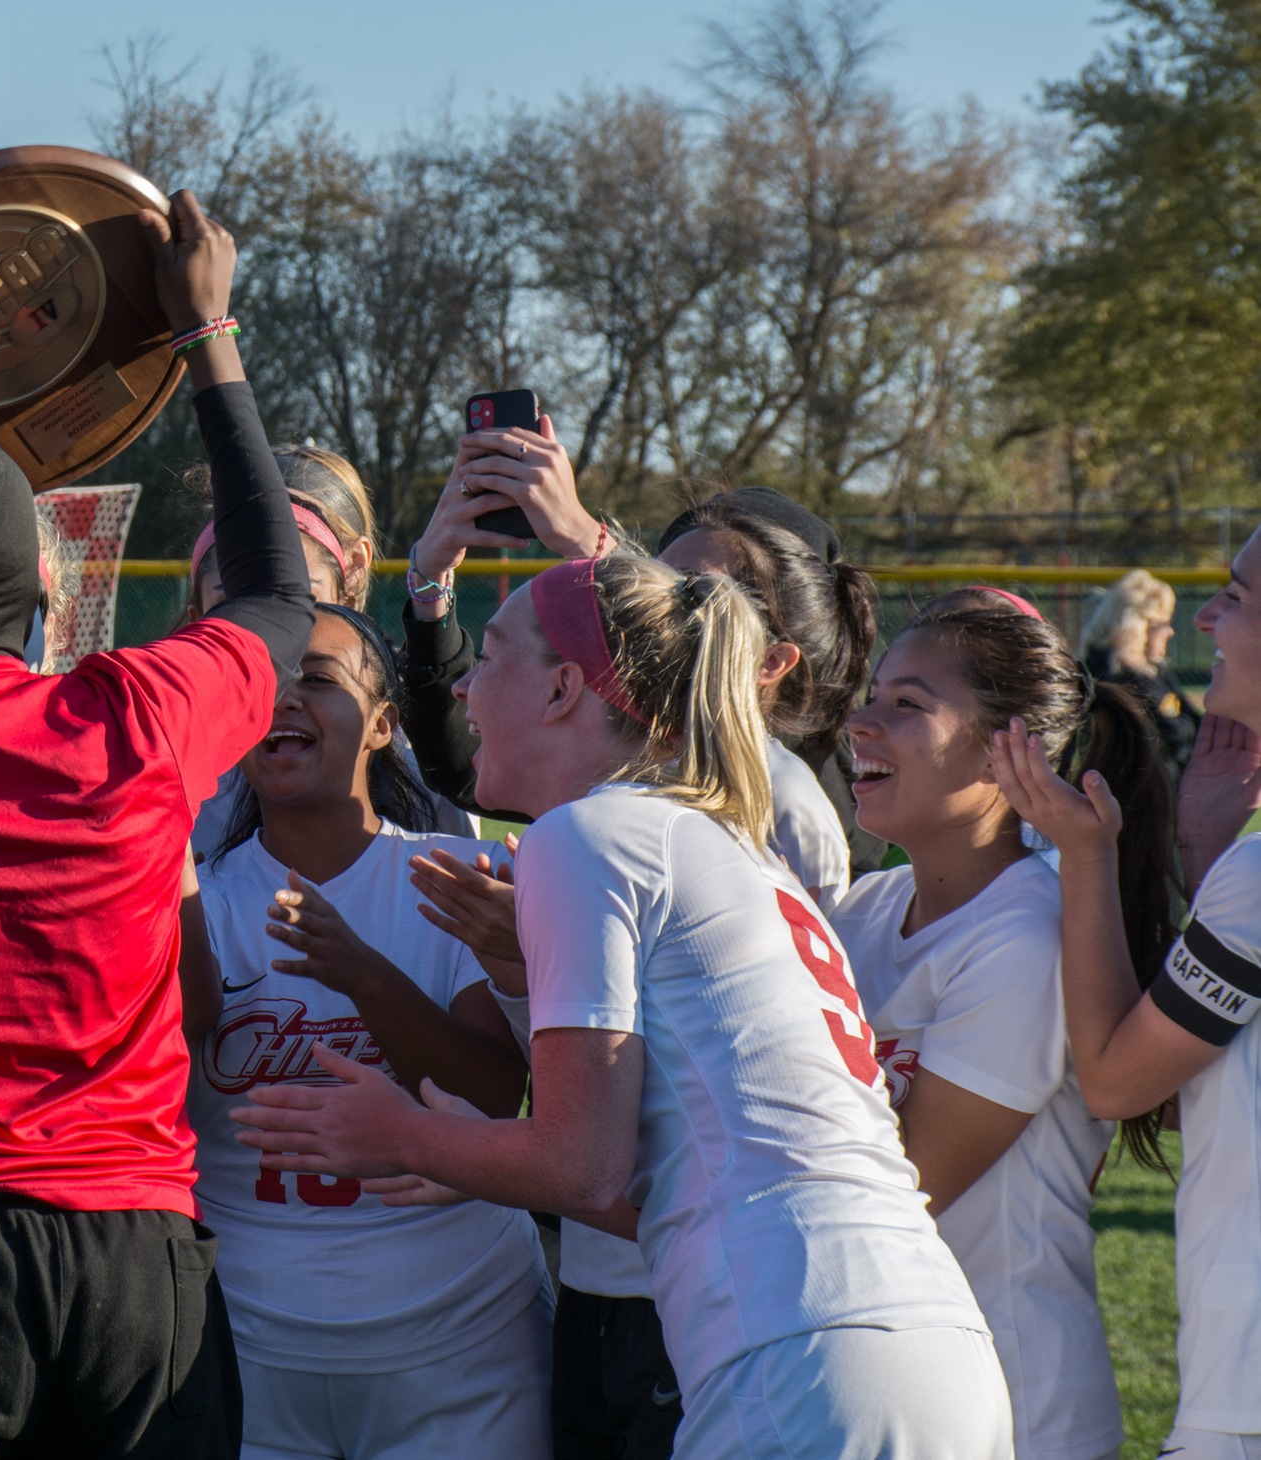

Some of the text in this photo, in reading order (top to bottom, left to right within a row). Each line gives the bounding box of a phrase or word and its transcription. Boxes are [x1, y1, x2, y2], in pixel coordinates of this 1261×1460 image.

[775, 888, 880, 1088] 9
[1173, 948, 1248, 1014] CAPTAIN
[300, 1020, 349, 1031] WOMEN'S
